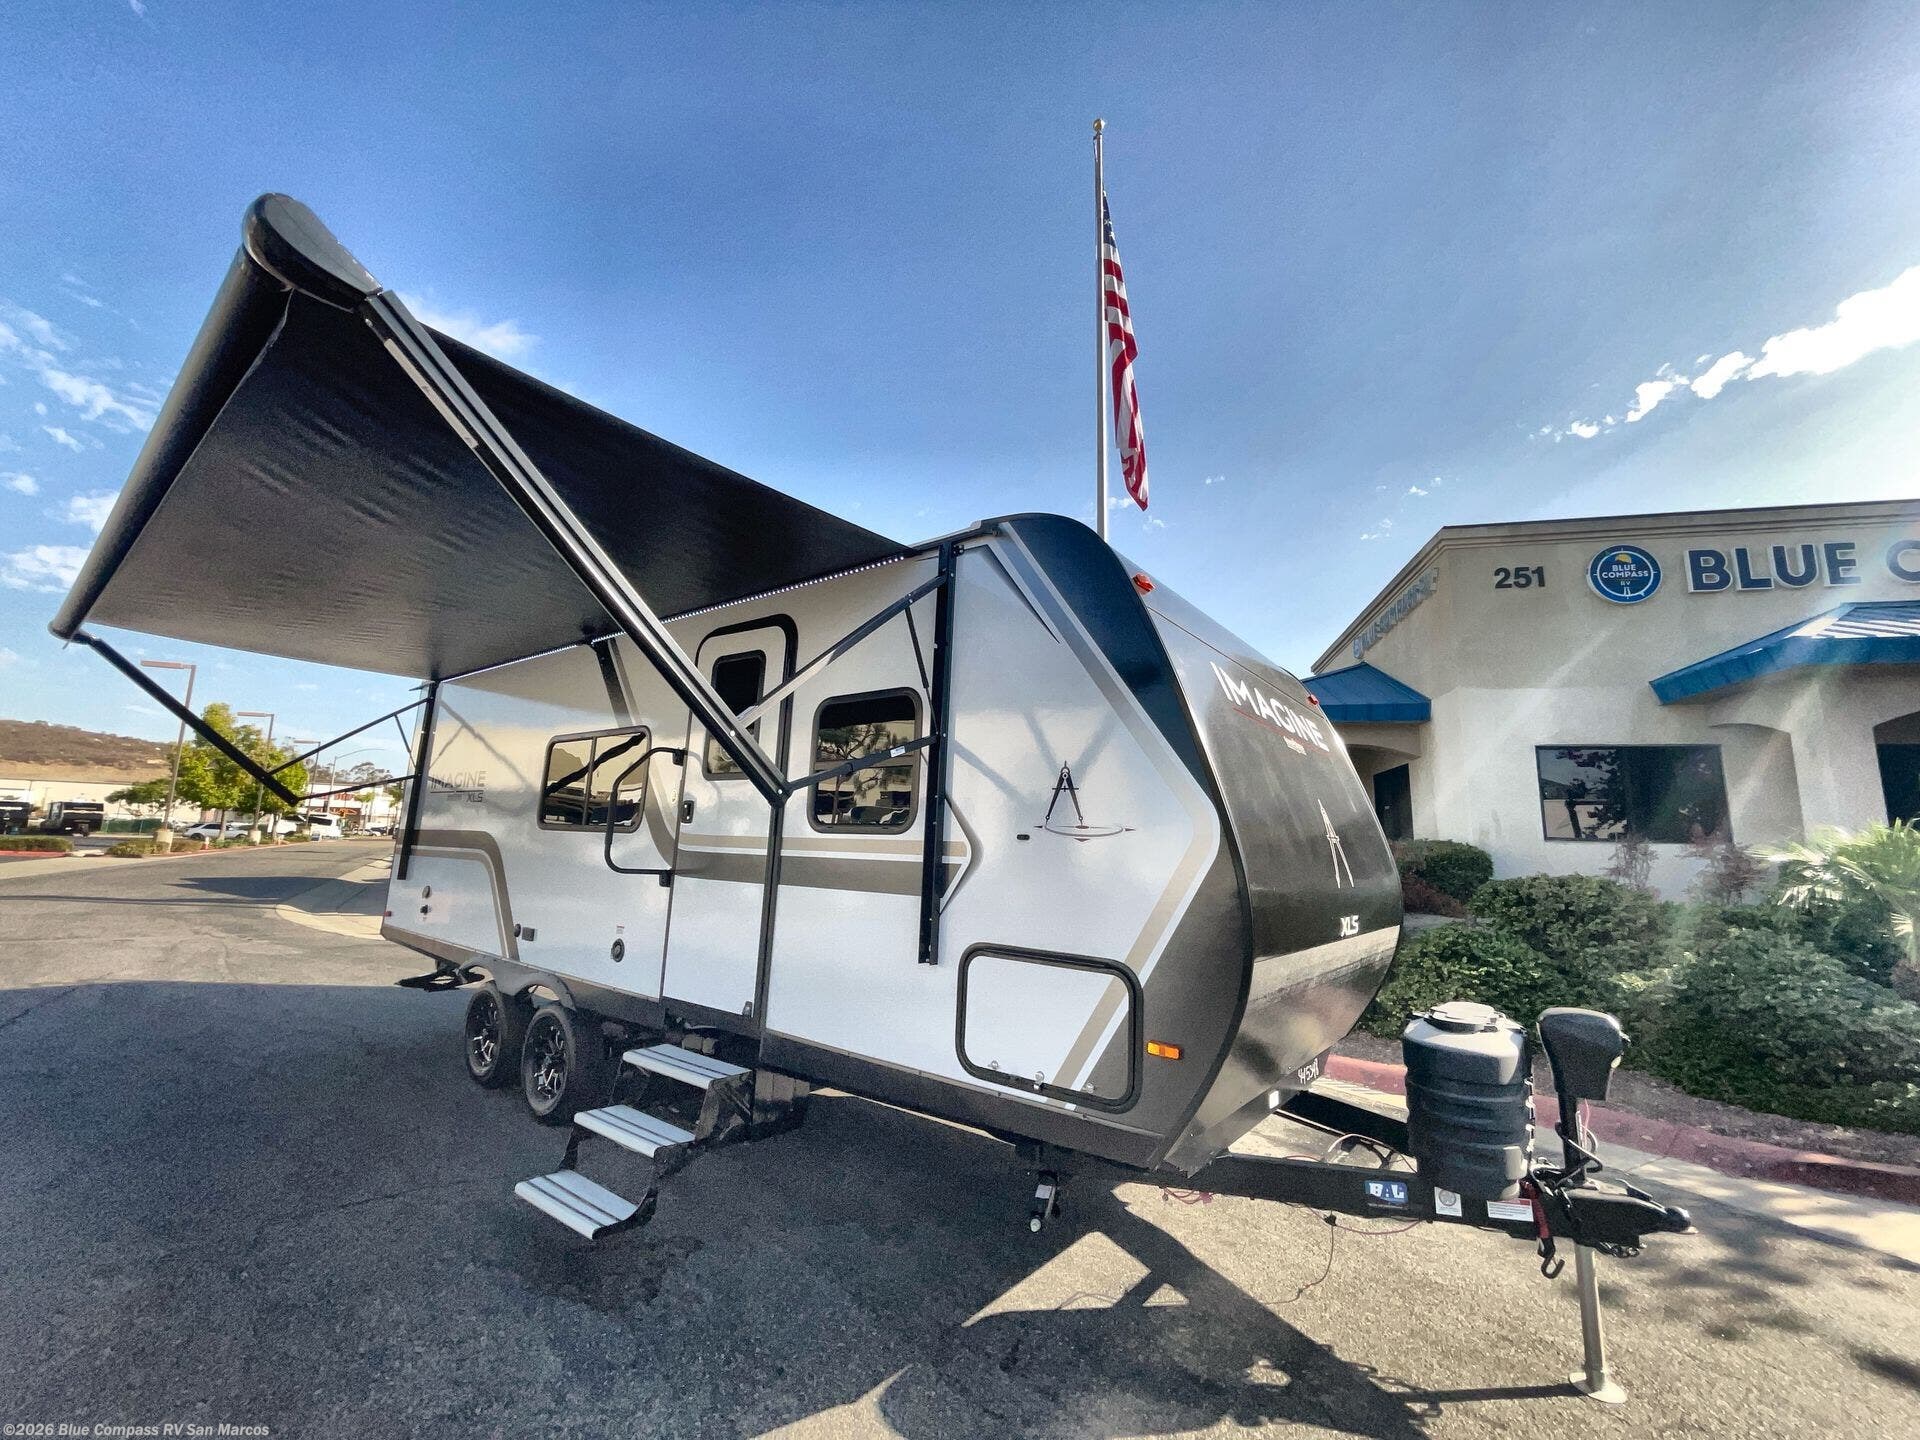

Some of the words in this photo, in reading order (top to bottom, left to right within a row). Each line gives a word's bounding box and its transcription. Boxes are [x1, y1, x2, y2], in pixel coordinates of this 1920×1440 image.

[1494, 566, 1546, 589] 251
[1601, 570, 1649, 579] COMPASS
[1685, 542, 1862, 592] BLUE
[1209, 660, 1330, 752] IMAGINE
[465, 792, 484, 803] XLS
[1340, 914, 1359, 938] XLS
